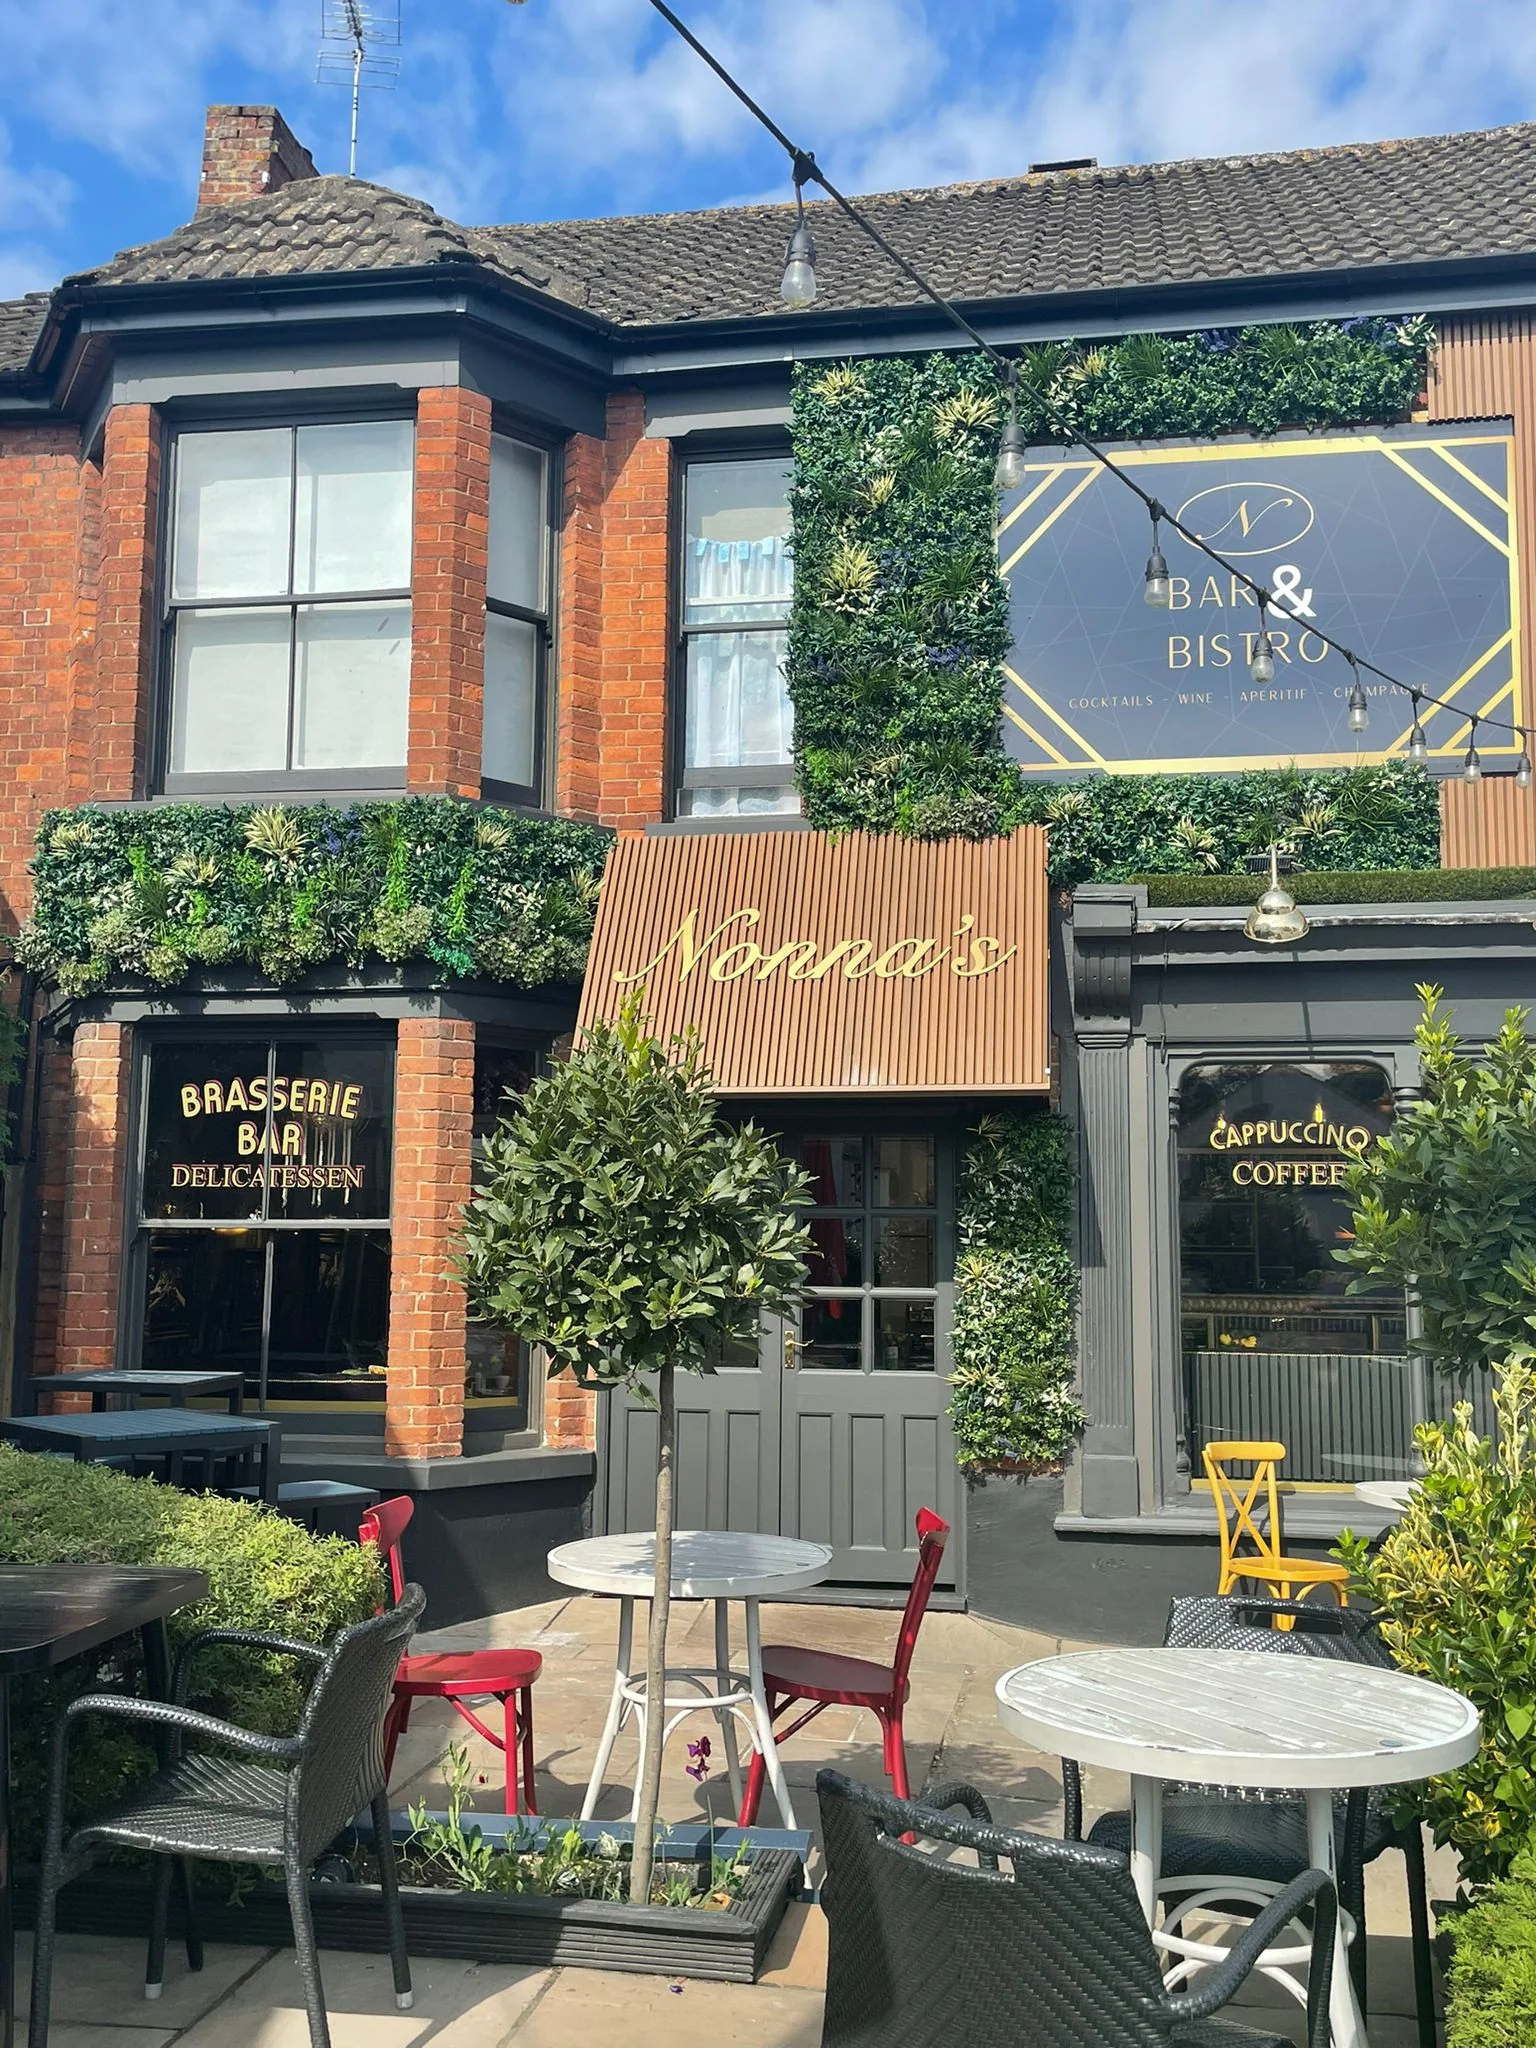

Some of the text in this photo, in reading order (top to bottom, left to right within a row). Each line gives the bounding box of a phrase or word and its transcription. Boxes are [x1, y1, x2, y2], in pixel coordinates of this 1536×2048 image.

[1194, 498, 1293, 538] N
[1168, 564, 1317, 619] BAR &
[1168, 630, 1329, 669] BISTRO
[1069, 682, 1431, 709] COCKTAILS WINE APERITIF CHMPAGE
[612, 907, 1018, 983] Nonna's
[181, 1076, 364, 1119] BRASSERIE
[238, 1121, 304, 1156] BAR
[1209, 1119, 1371, 1151] CAPPUCCINO
[171, 1163, 366, 1189] DELICATESSEN
[1232, 1160, 1347, 1186] COFFEE
